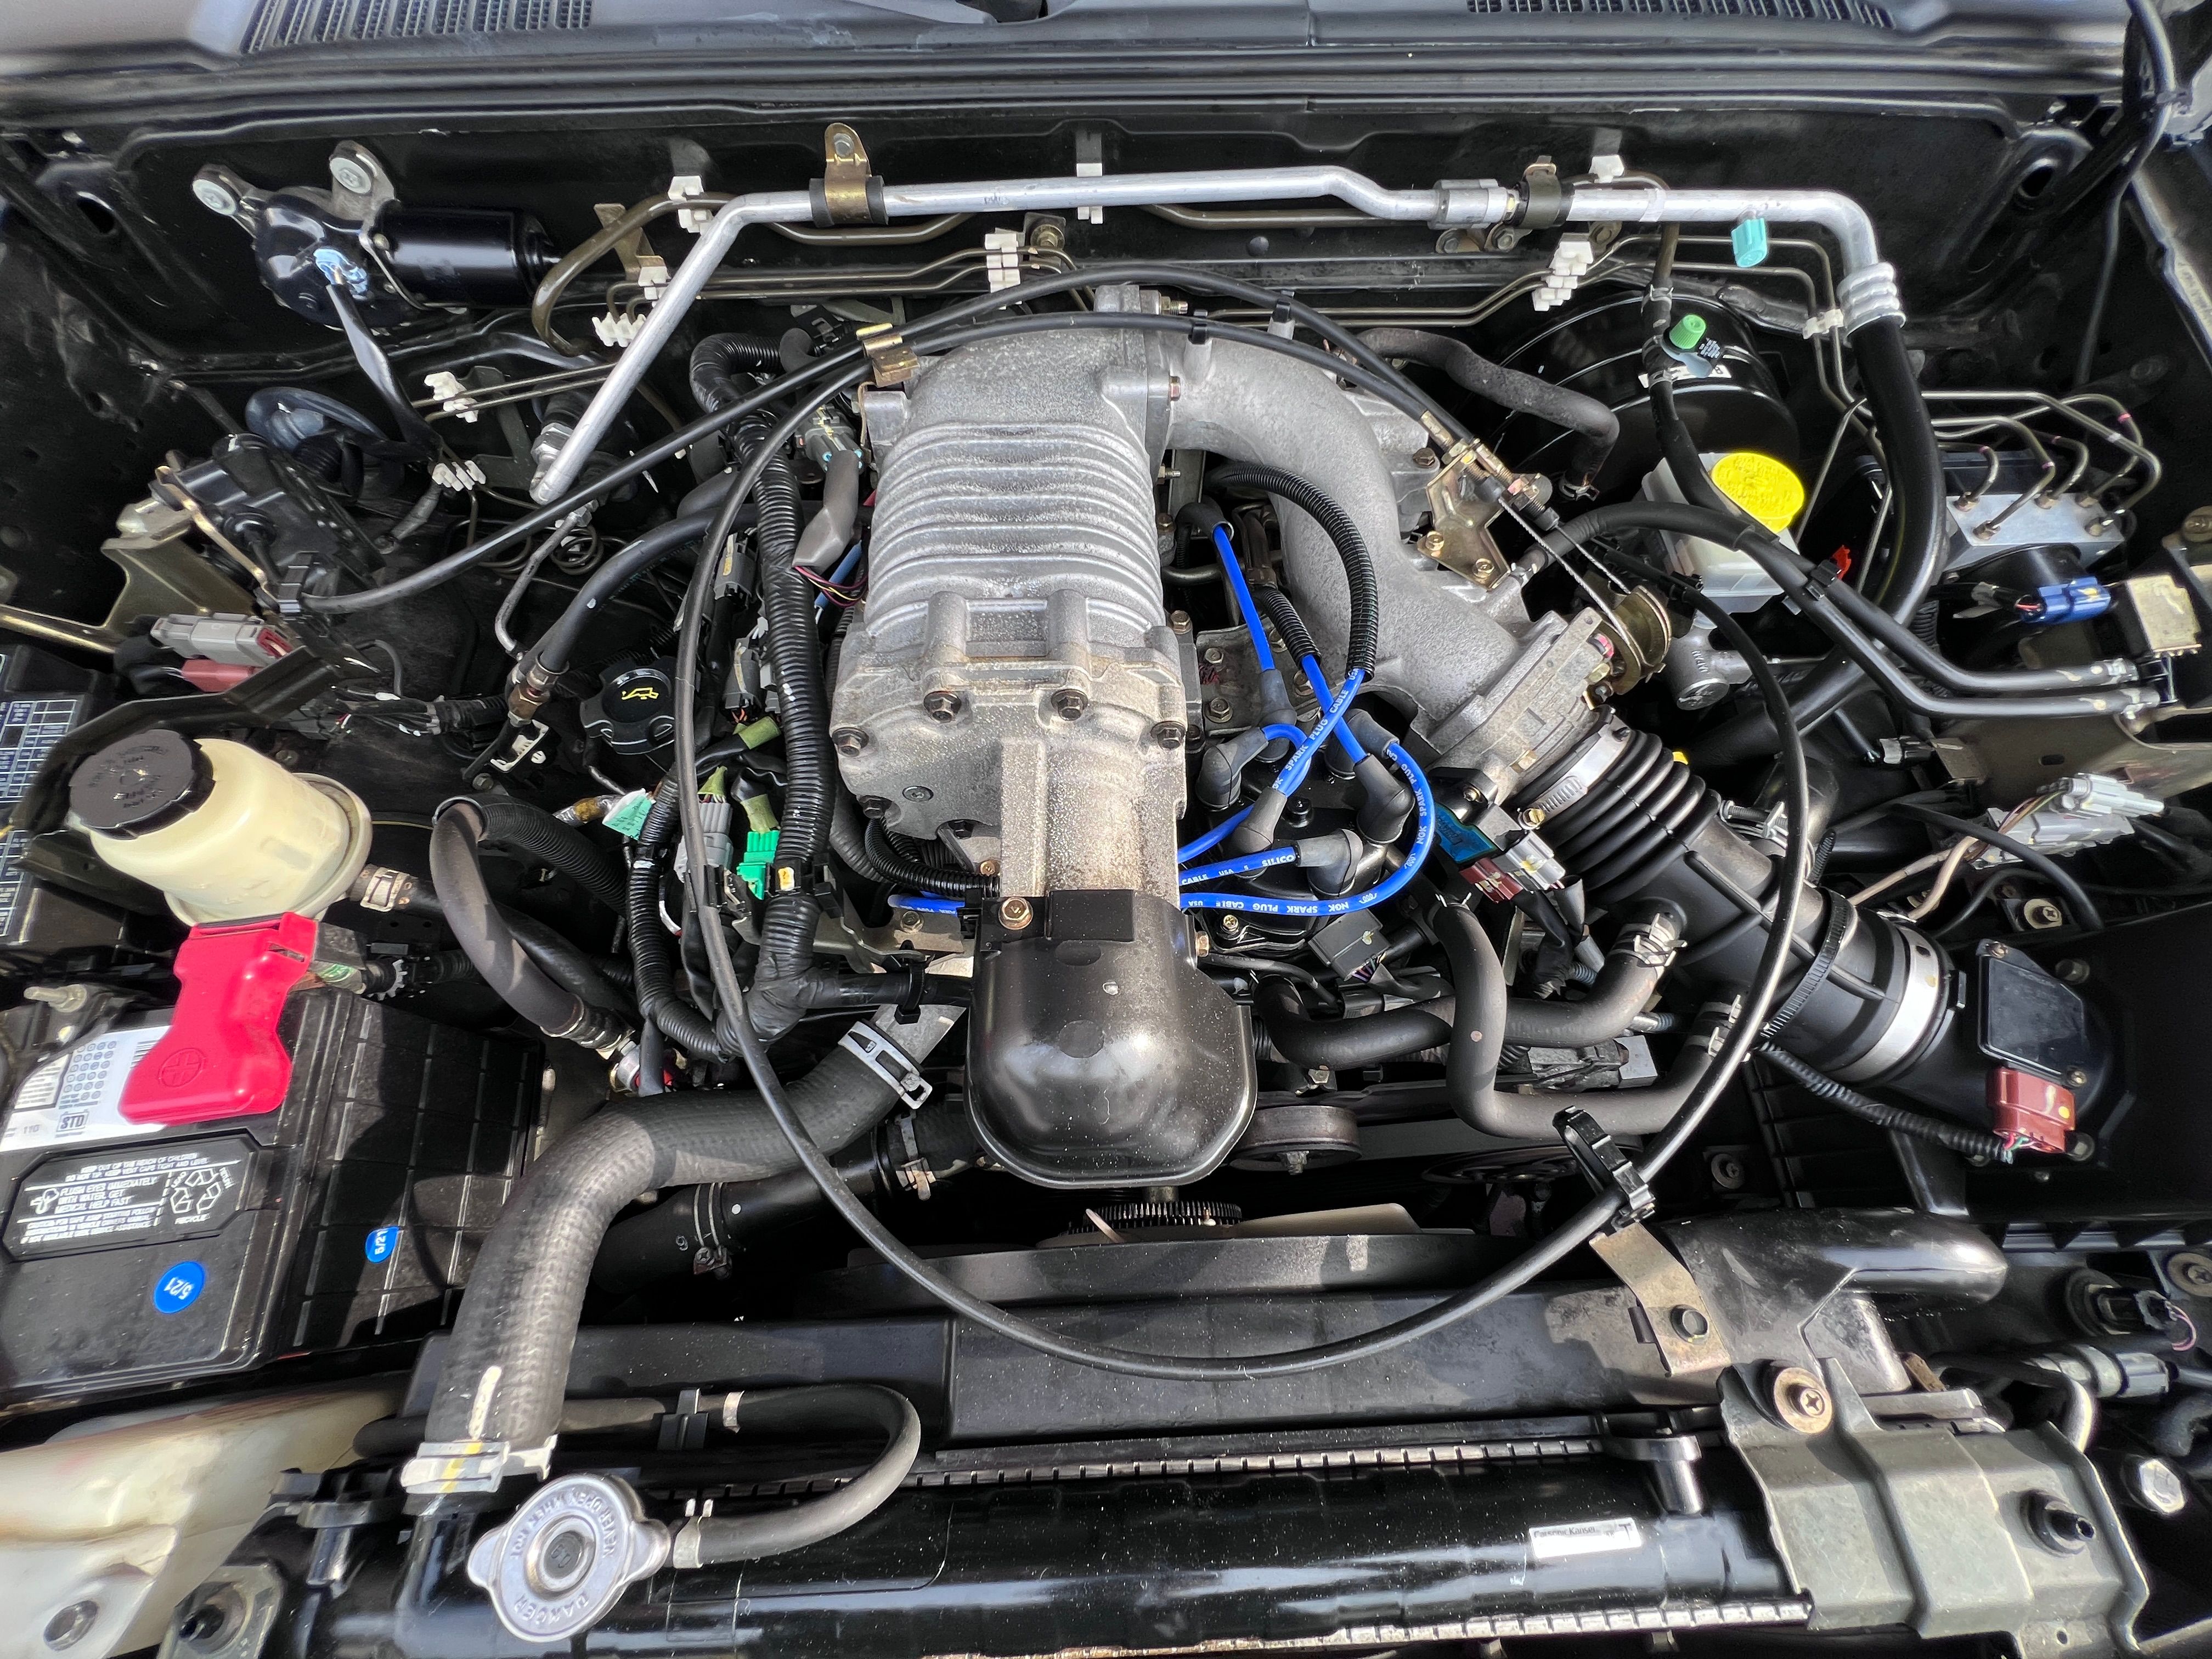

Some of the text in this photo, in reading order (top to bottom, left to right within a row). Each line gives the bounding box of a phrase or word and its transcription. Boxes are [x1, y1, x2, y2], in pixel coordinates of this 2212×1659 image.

[1272, 777, 1284, 789] GK
[1285, 744, 1309, 771] SPARK
[1309, 718, 1328, 741] PLUG
[1329, 689, 1349, 714] CABLE
[1401, 763, 1418, 785] PLUG
[1414, 788, 1427, 817] SPARK
[1416, 825, 1427, 845] NGK
[1181, 873, 1209, 885] CABLE
[1218, 868, 1235, 877] USA
[1252, 902, 1279, 913] PLUG
[1286, 905, 1318, 914] SPARK
[1328, 901, 1350, 912] NGK
[375, 1230, 388, 1255] 5/21
[163, 1277, 194, 1300] 5/21
[514, 1592, 589, 1626] DANGER
